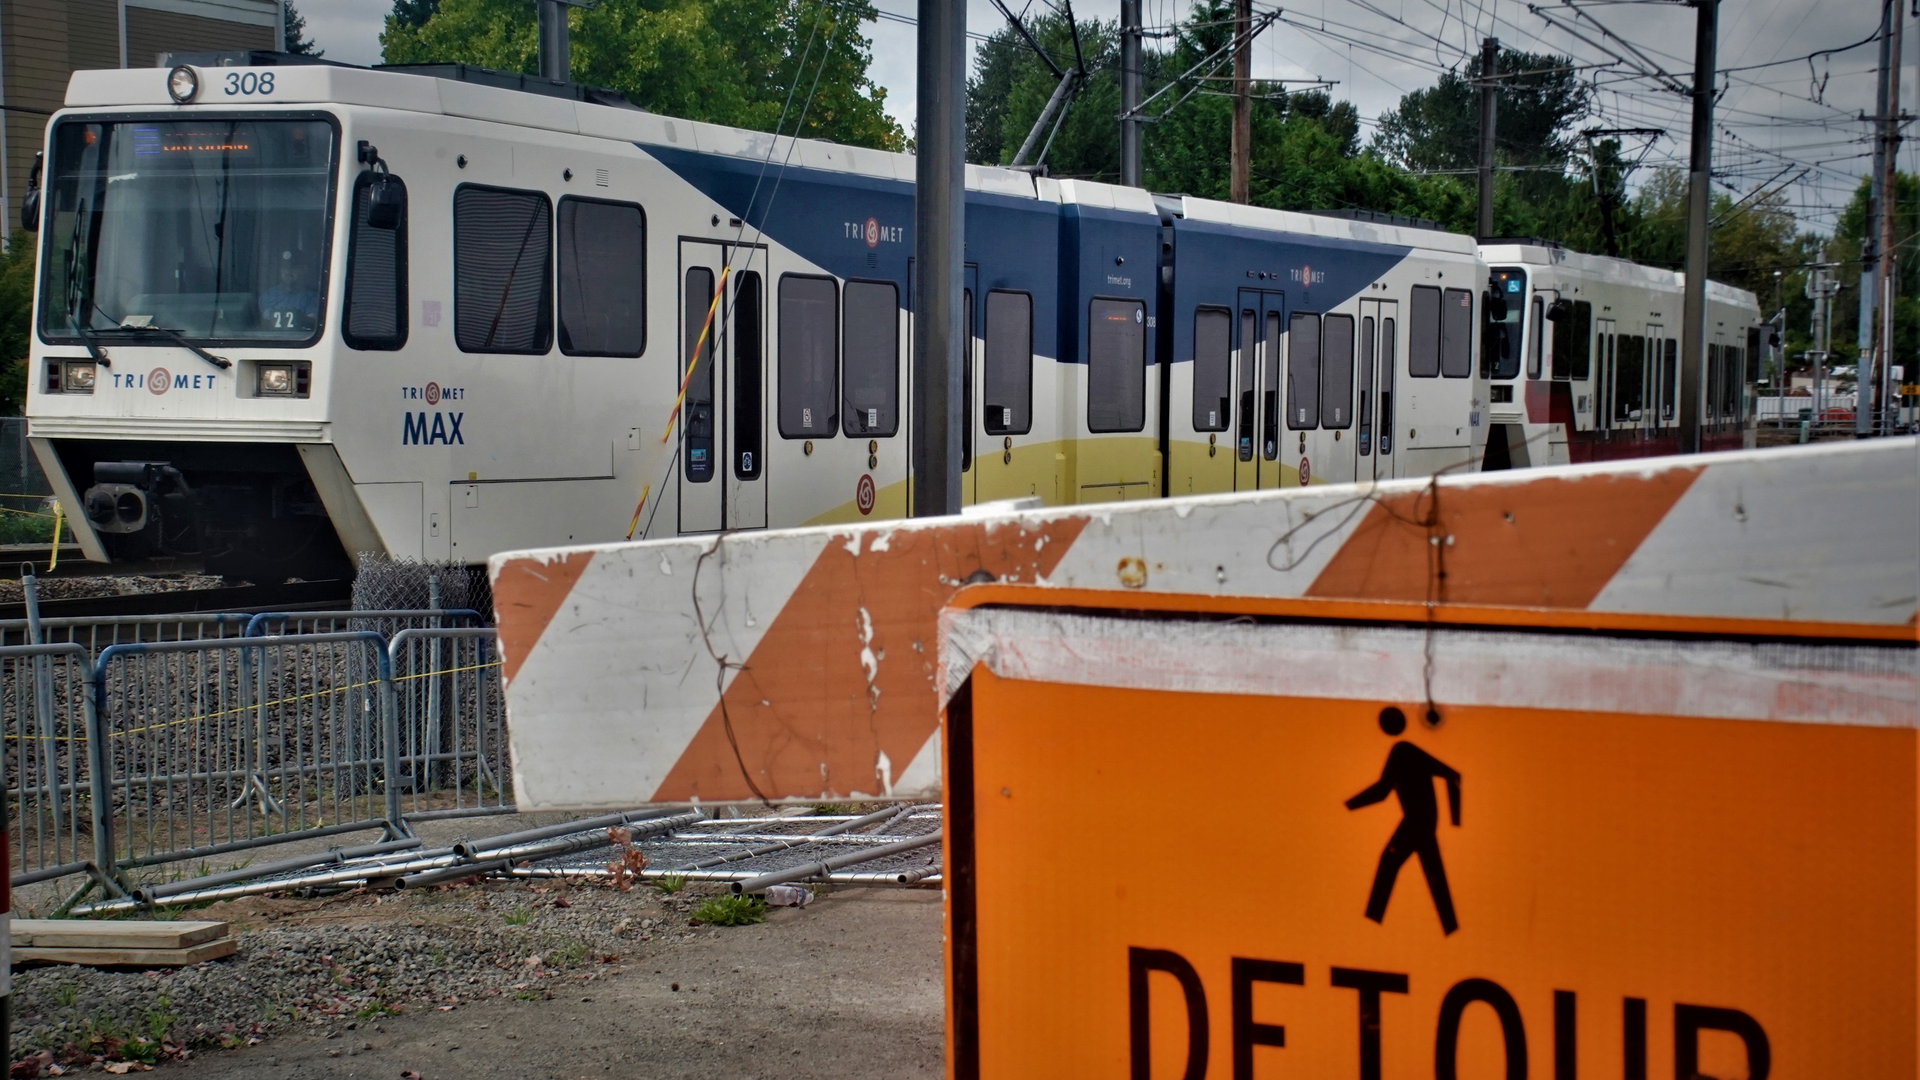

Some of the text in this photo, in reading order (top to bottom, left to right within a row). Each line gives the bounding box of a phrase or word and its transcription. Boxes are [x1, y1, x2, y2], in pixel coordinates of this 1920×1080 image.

[224, 72, 275, 96] 308
[844, 222, 903, 243] TRI MET
[1146, 316, 1156, 328] 308
[113, 373, 216, 389] TRI MET
[402, 387, 465, 400] TRI MET
[402, 411, 465, 446] MAX
